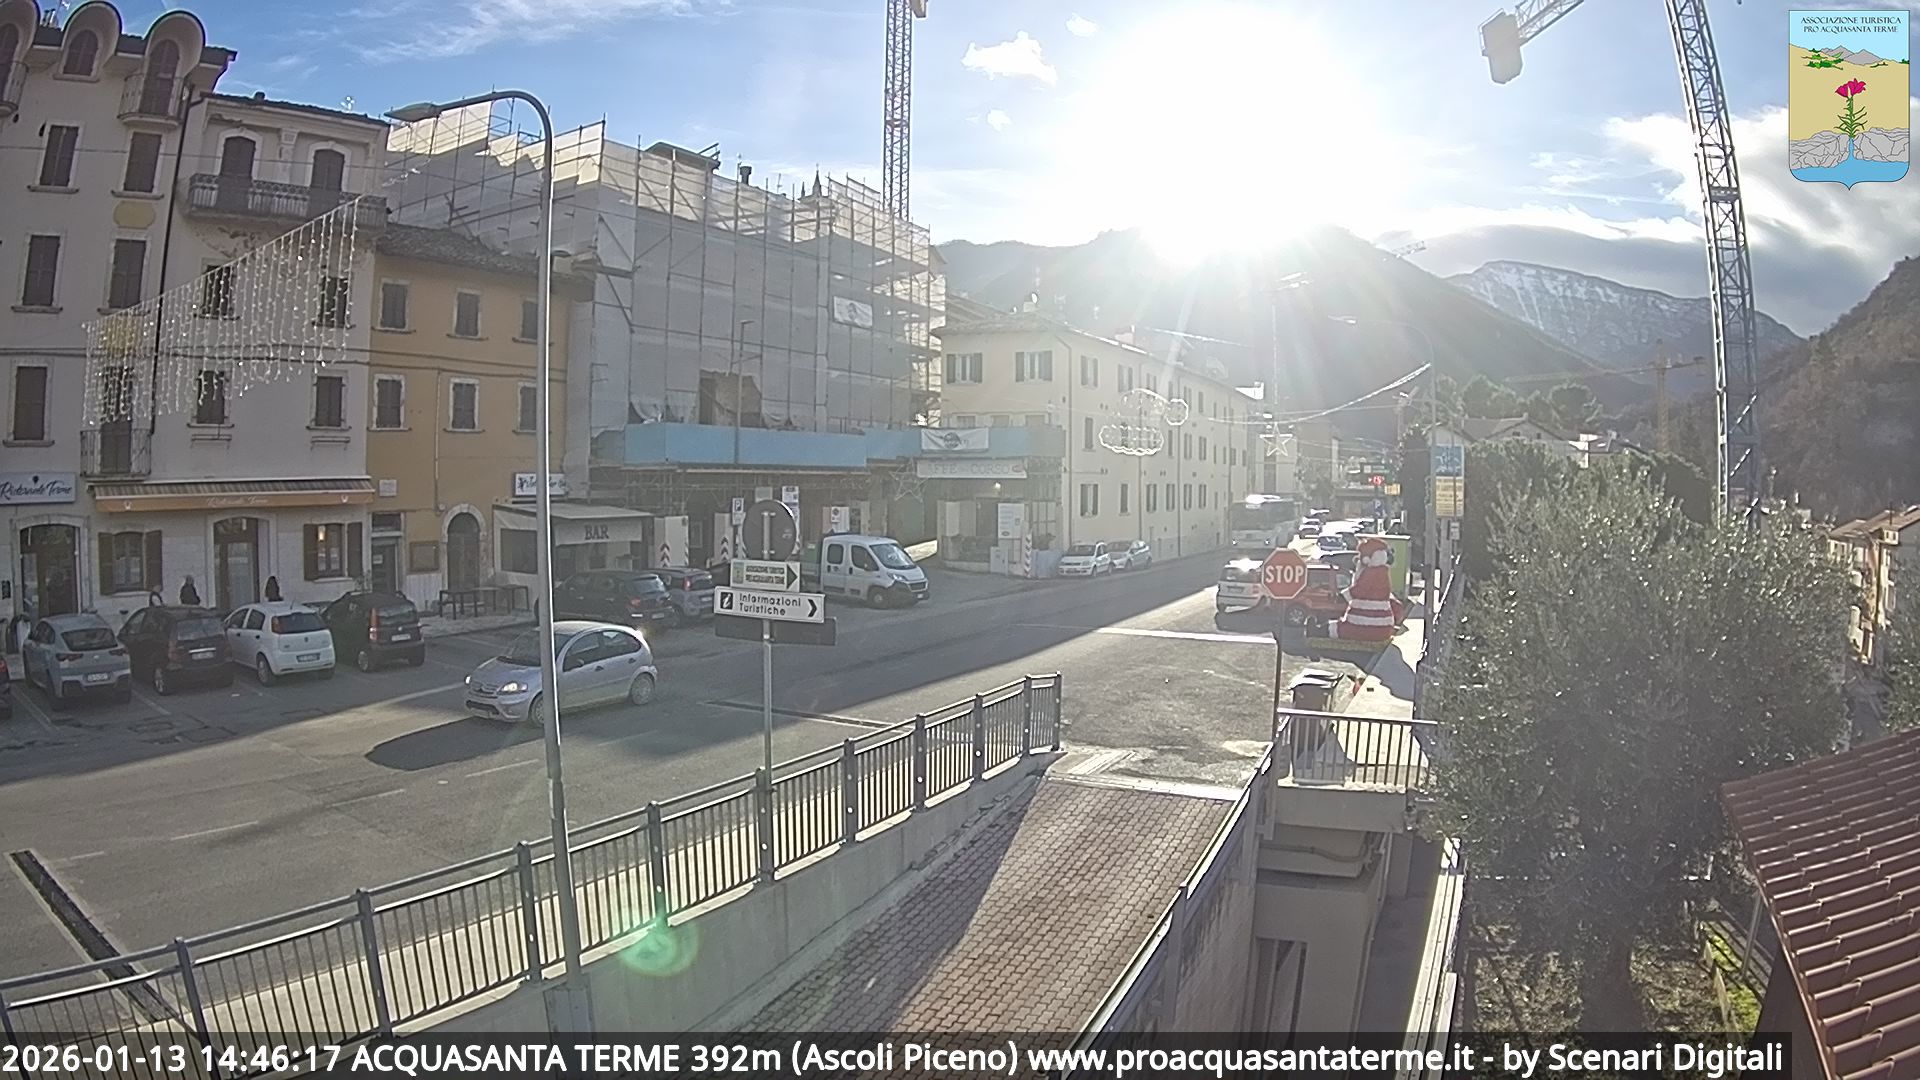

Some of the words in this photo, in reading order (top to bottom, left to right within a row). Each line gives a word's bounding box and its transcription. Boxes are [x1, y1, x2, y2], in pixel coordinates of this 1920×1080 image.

[584, 524, 609, 540] BAR
[1265, 564, 1304, 584] STOP
[740, 593, 801, 606] Informazioni
[739, 602, 786, 616] Turistiche
